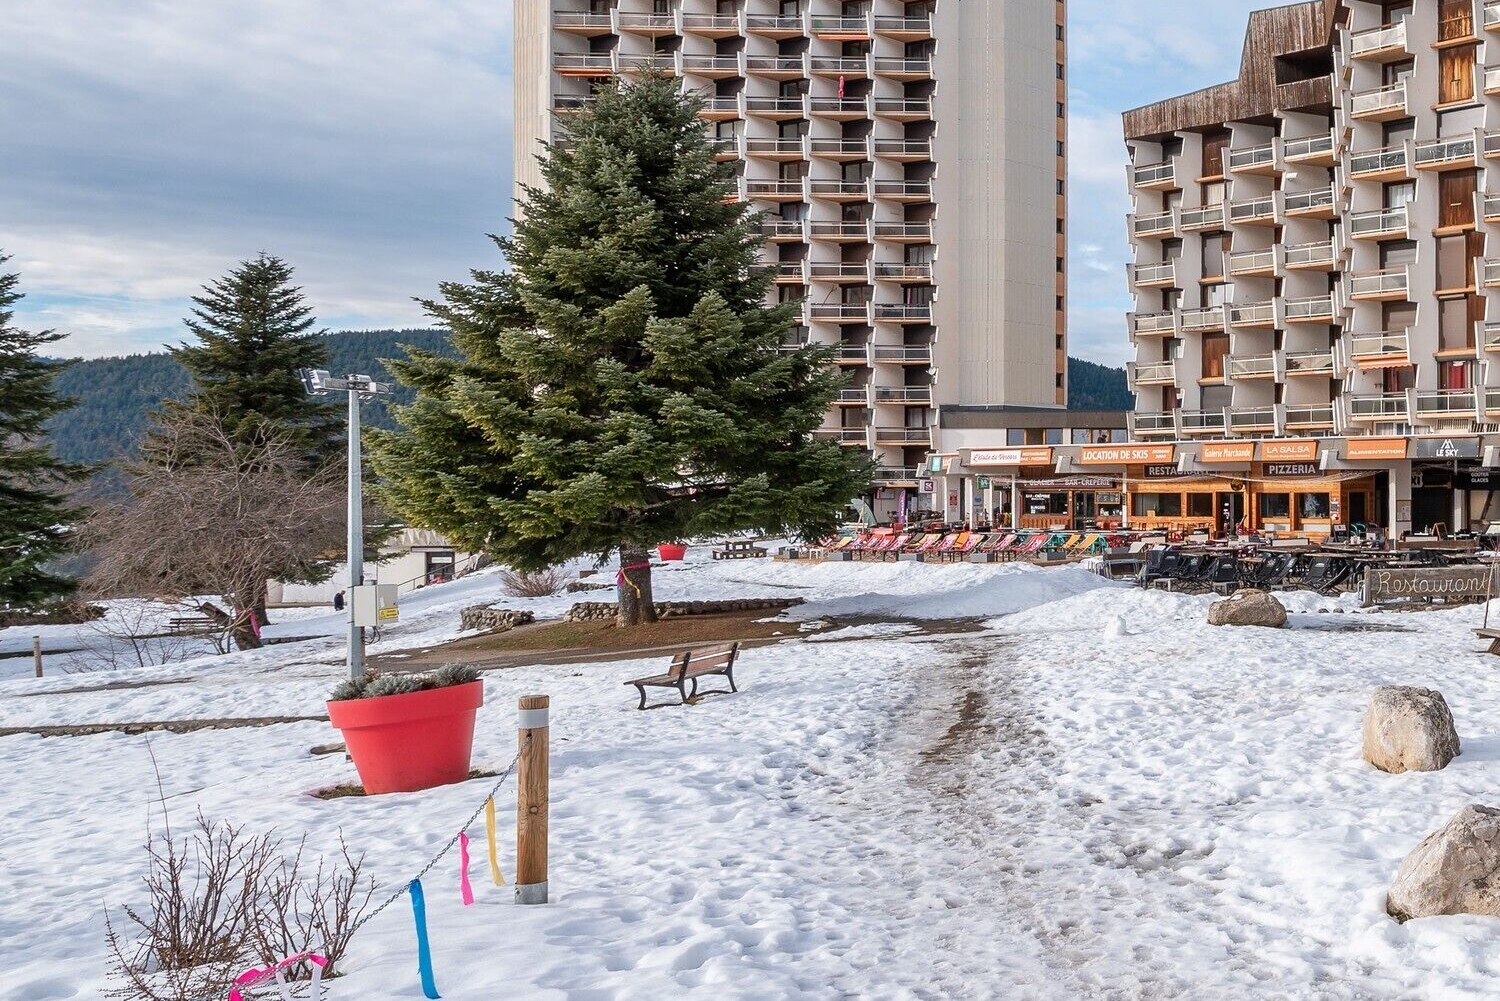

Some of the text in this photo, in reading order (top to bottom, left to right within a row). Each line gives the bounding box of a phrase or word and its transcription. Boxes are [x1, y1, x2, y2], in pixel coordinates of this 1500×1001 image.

[1204, 448, 1251, 457] Galerie Marchande
[1279, 445, 1310, 453] SALSA
[1436, 449, 1459, 457] LE SKY
[1083, 450, 1118, 460] LOCATION
[1120, 450, 1131, 459] DE
[1132, 449, 1149, 459] SKIS
[1269, 464, 1316, 475] PIZZERIA
[1376, 571, 1492, 595] Restaurant
